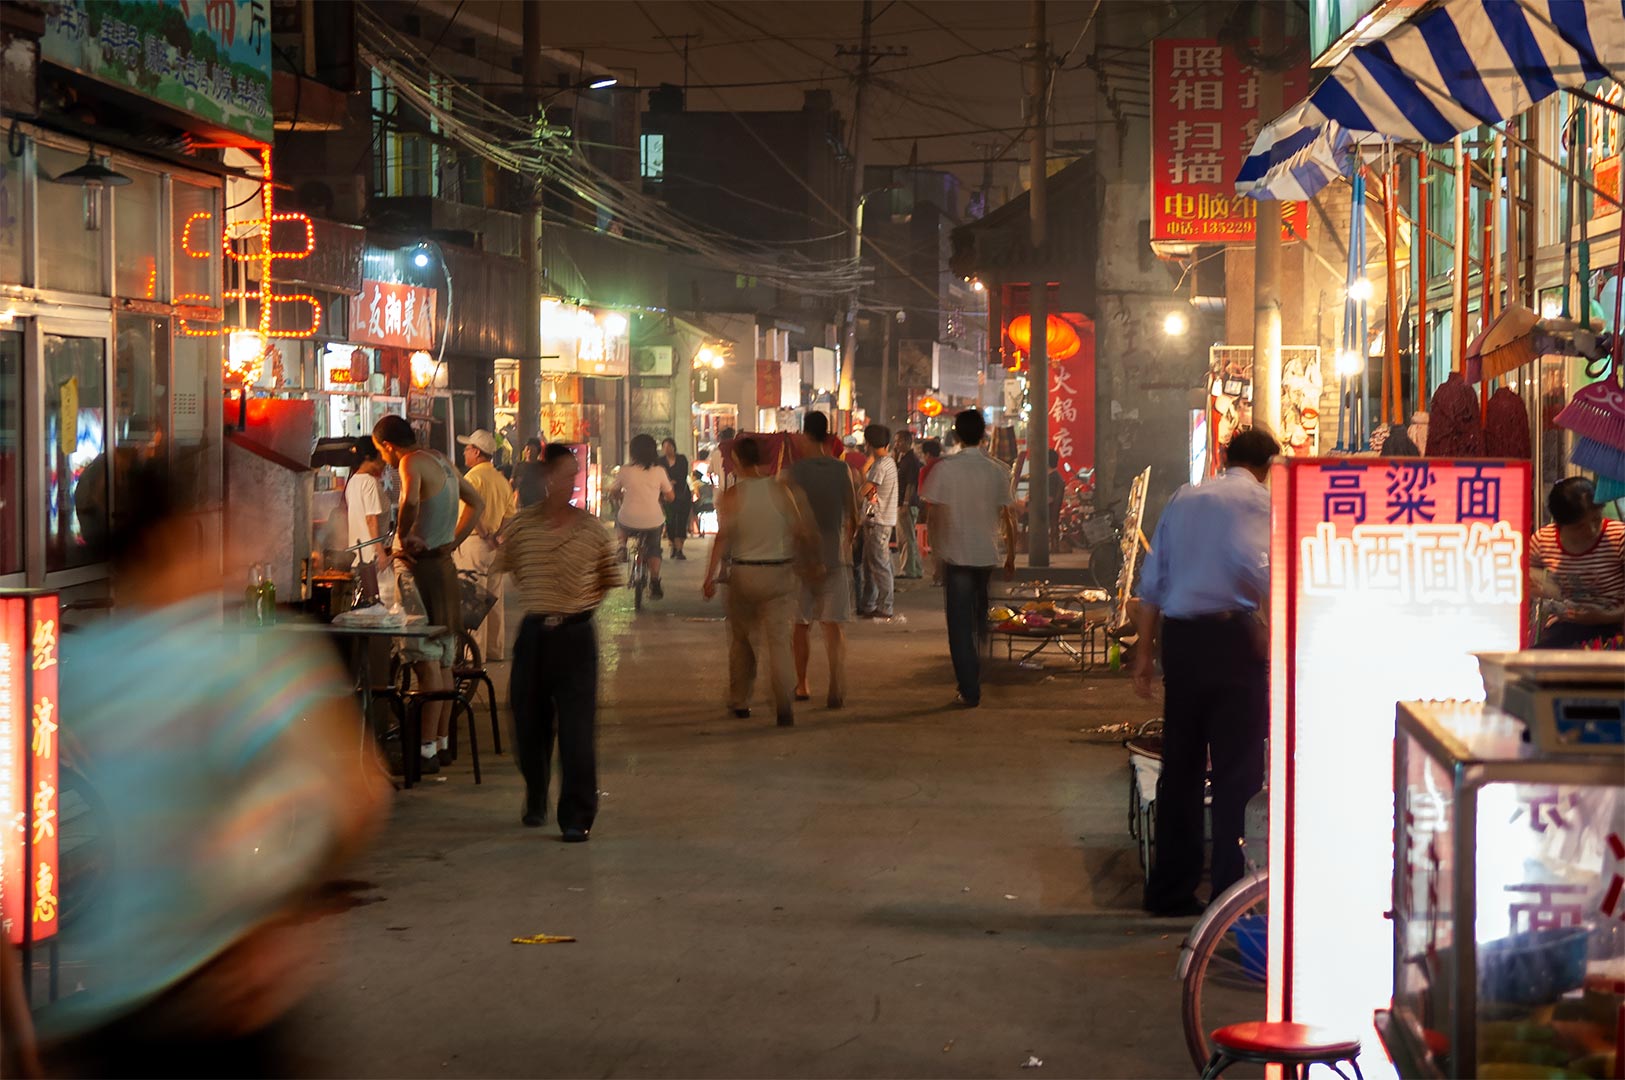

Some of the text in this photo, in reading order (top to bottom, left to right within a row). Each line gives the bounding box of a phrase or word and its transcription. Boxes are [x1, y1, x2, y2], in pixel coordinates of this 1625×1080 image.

[1048, 366, 1077, 458] 火锅店
[1320, 461, 1504, 523] 高粱面
[1302, 521, 1523, 604] 山西面馆
[32, 619, 58, 922] 经济实惠
